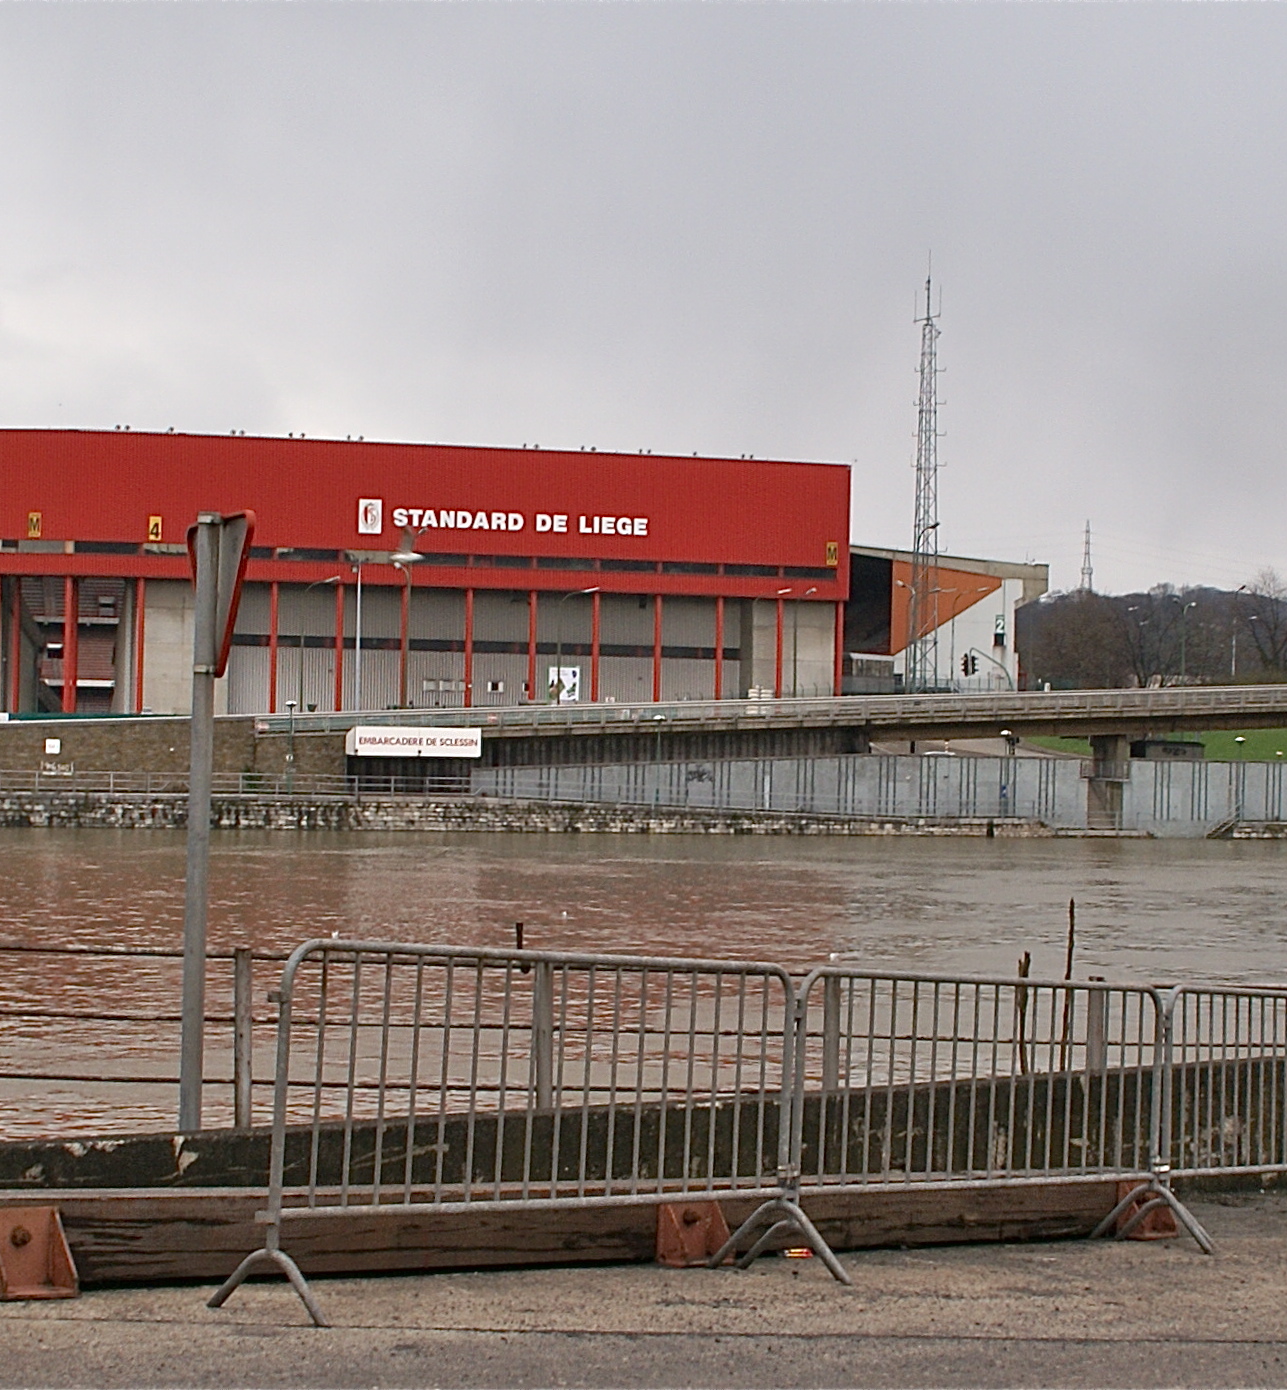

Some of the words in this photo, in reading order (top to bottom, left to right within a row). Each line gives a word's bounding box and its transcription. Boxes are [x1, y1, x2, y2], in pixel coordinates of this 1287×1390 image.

[392, 508, 524, 531] STANDARD
[535, 513, 568, 533] DE
[579, 515, 648, 536] LIEGE
[150, 522, 160, 538] 4
[996, 619, 1005, 633] 2
[359, 737, 423, 746] EMBARCADERE
[426, 737, 437, 746] DE
[440, 738, 478, 747] SCLESSIN
